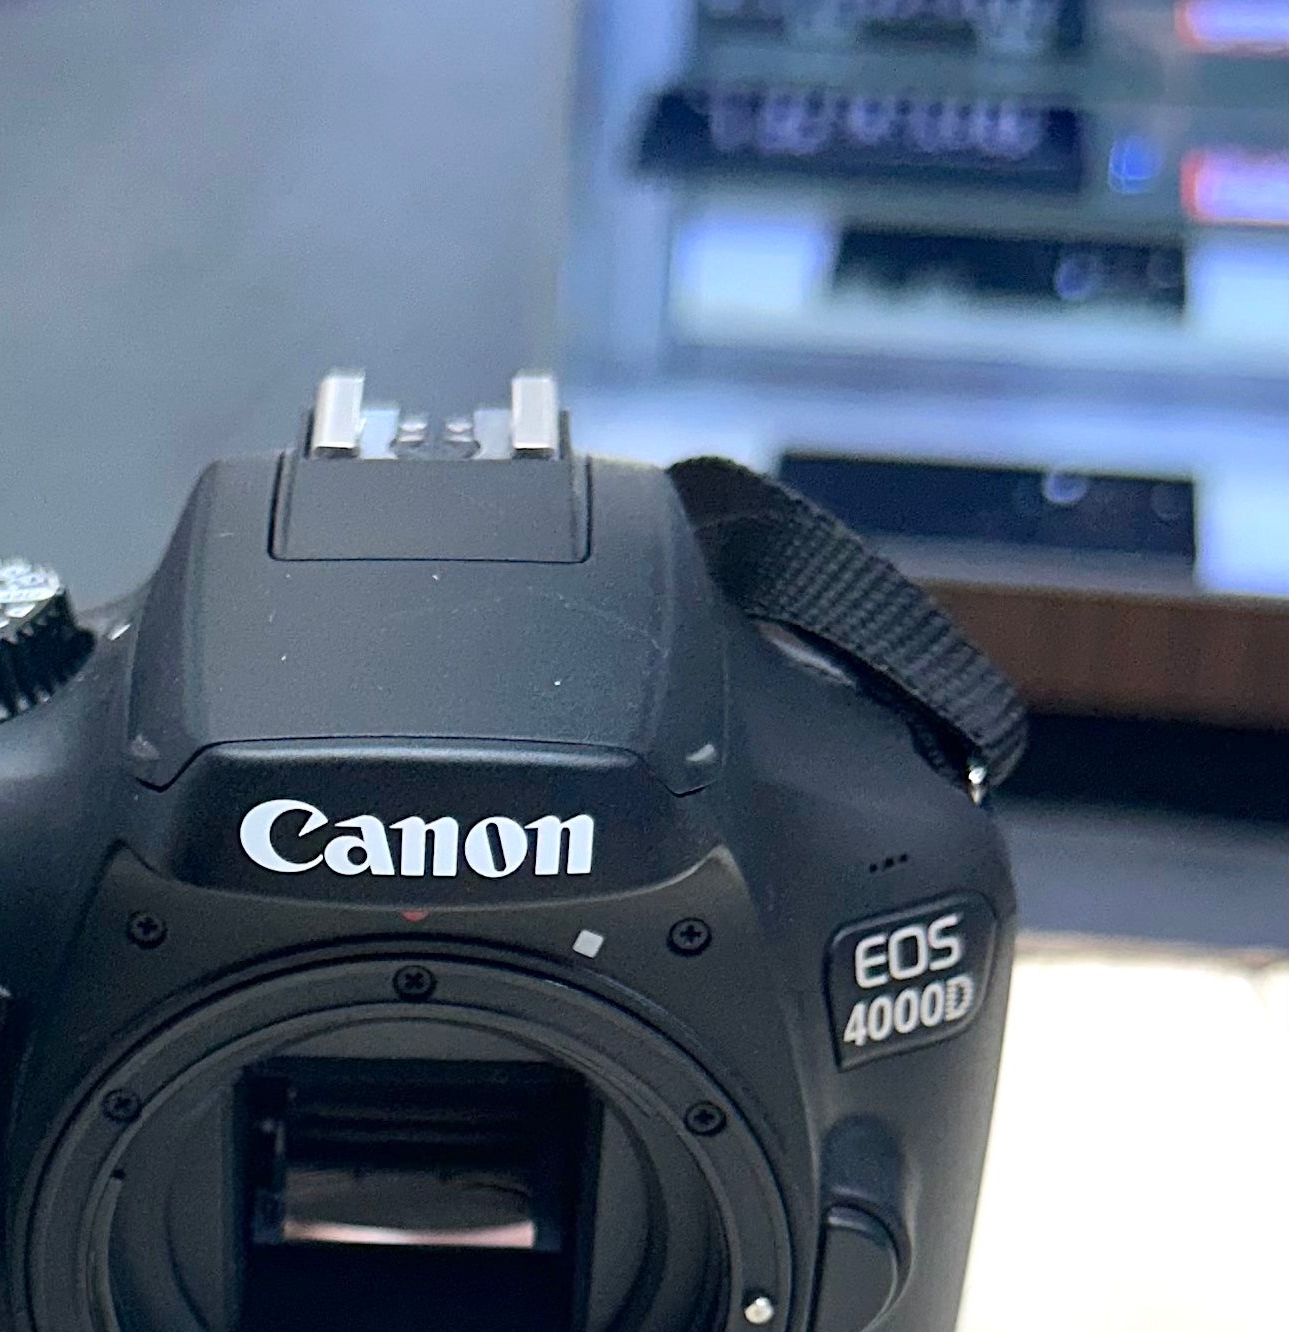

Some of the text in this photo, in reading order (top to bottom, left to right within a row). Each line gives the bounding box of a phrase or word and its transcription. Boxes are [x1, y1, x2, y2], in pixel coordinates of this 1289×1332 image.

[240, 799, 594, 878] Canon
[855, 914, 962, 988] EOS
[843, 975, 973, 1045] 4000D
